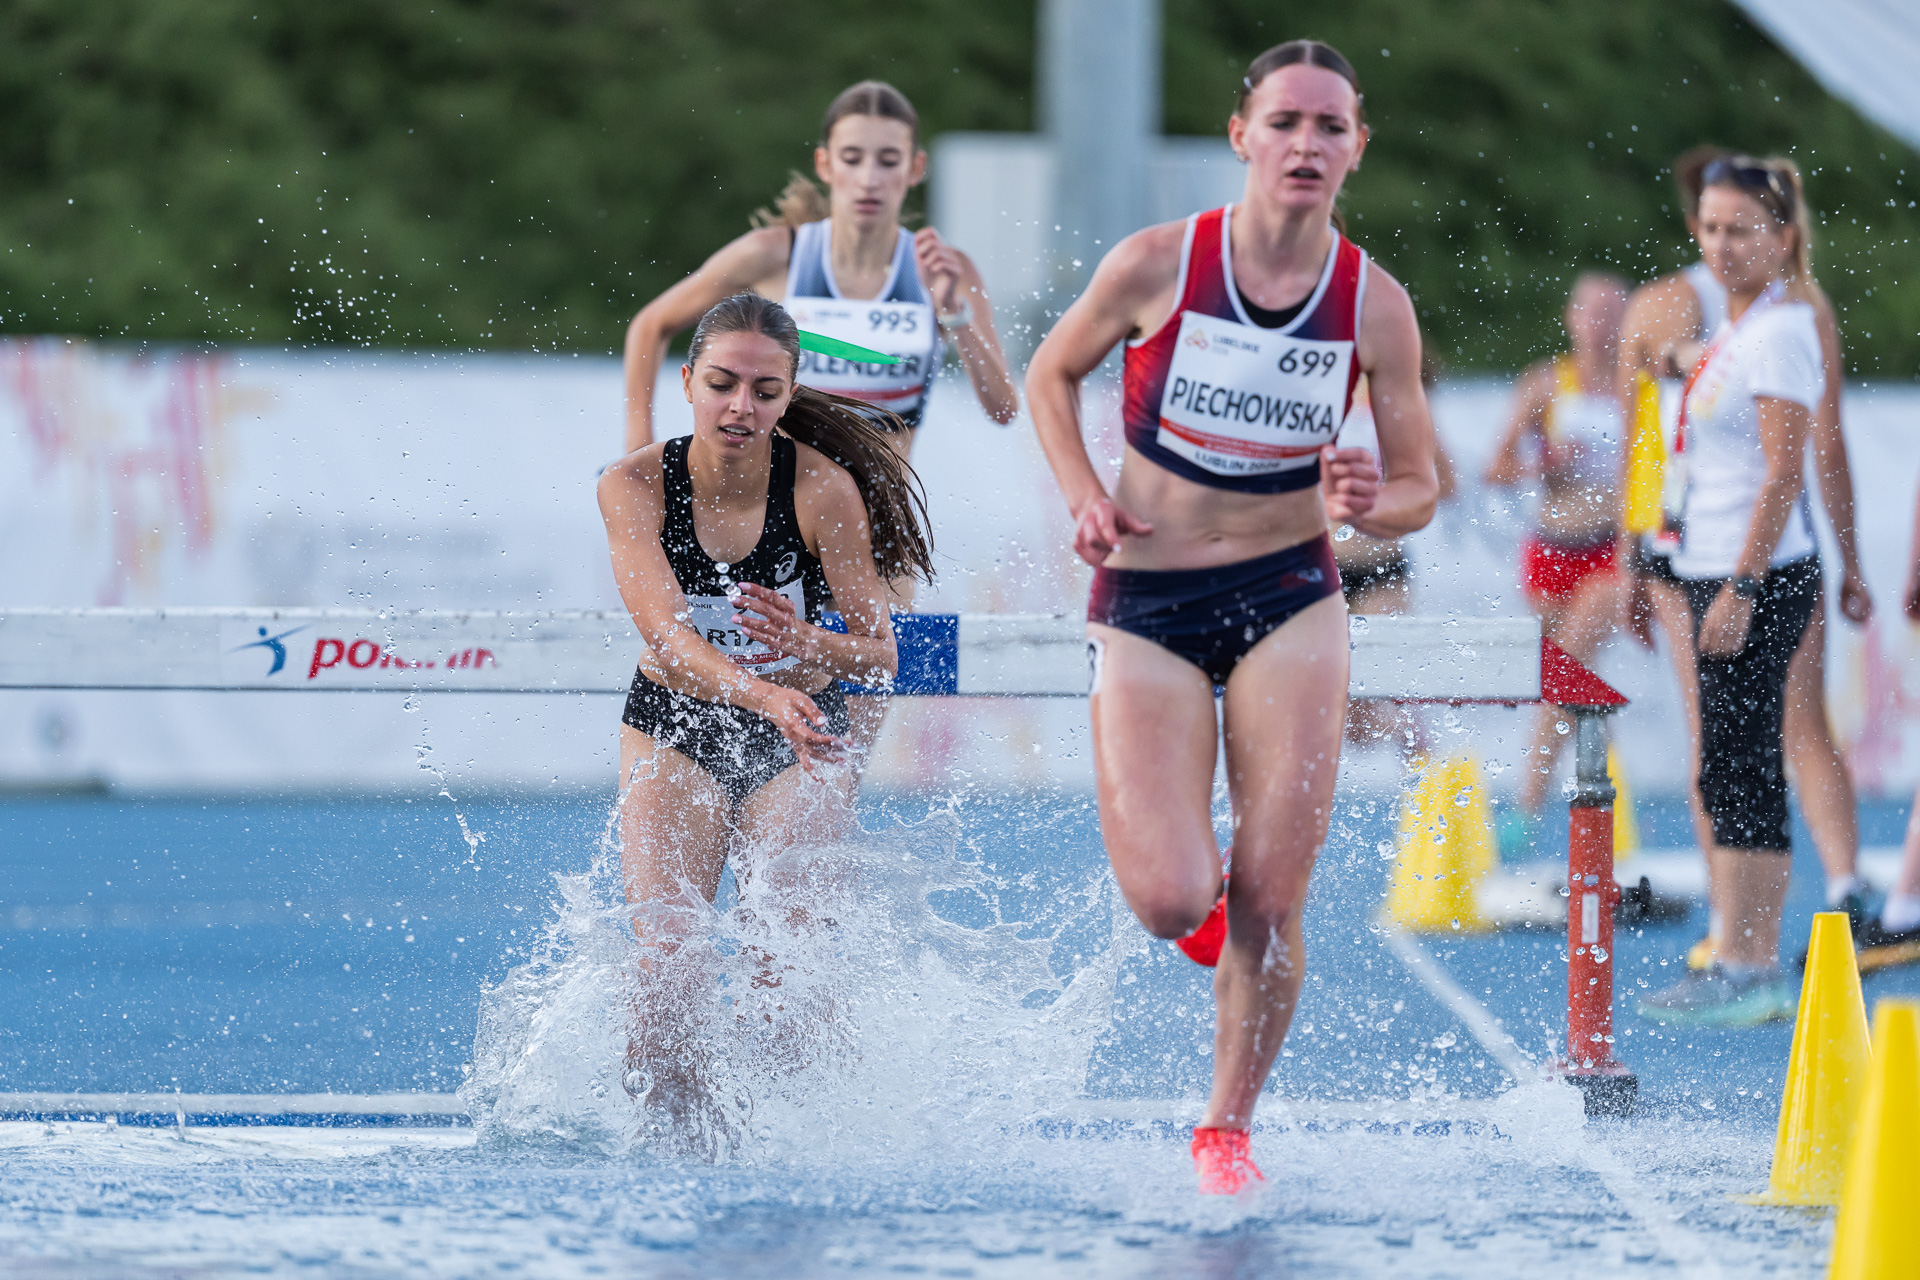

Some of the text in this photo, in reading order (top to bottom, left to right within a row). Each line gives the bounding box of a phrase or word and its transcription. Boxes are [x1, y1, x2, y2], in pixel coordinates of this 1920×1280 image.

[868, 309, 918, 332] 995
[1278, 347, 1337, 377] 699
[1169, 376, 1334, 434] PIECHOWSKA
